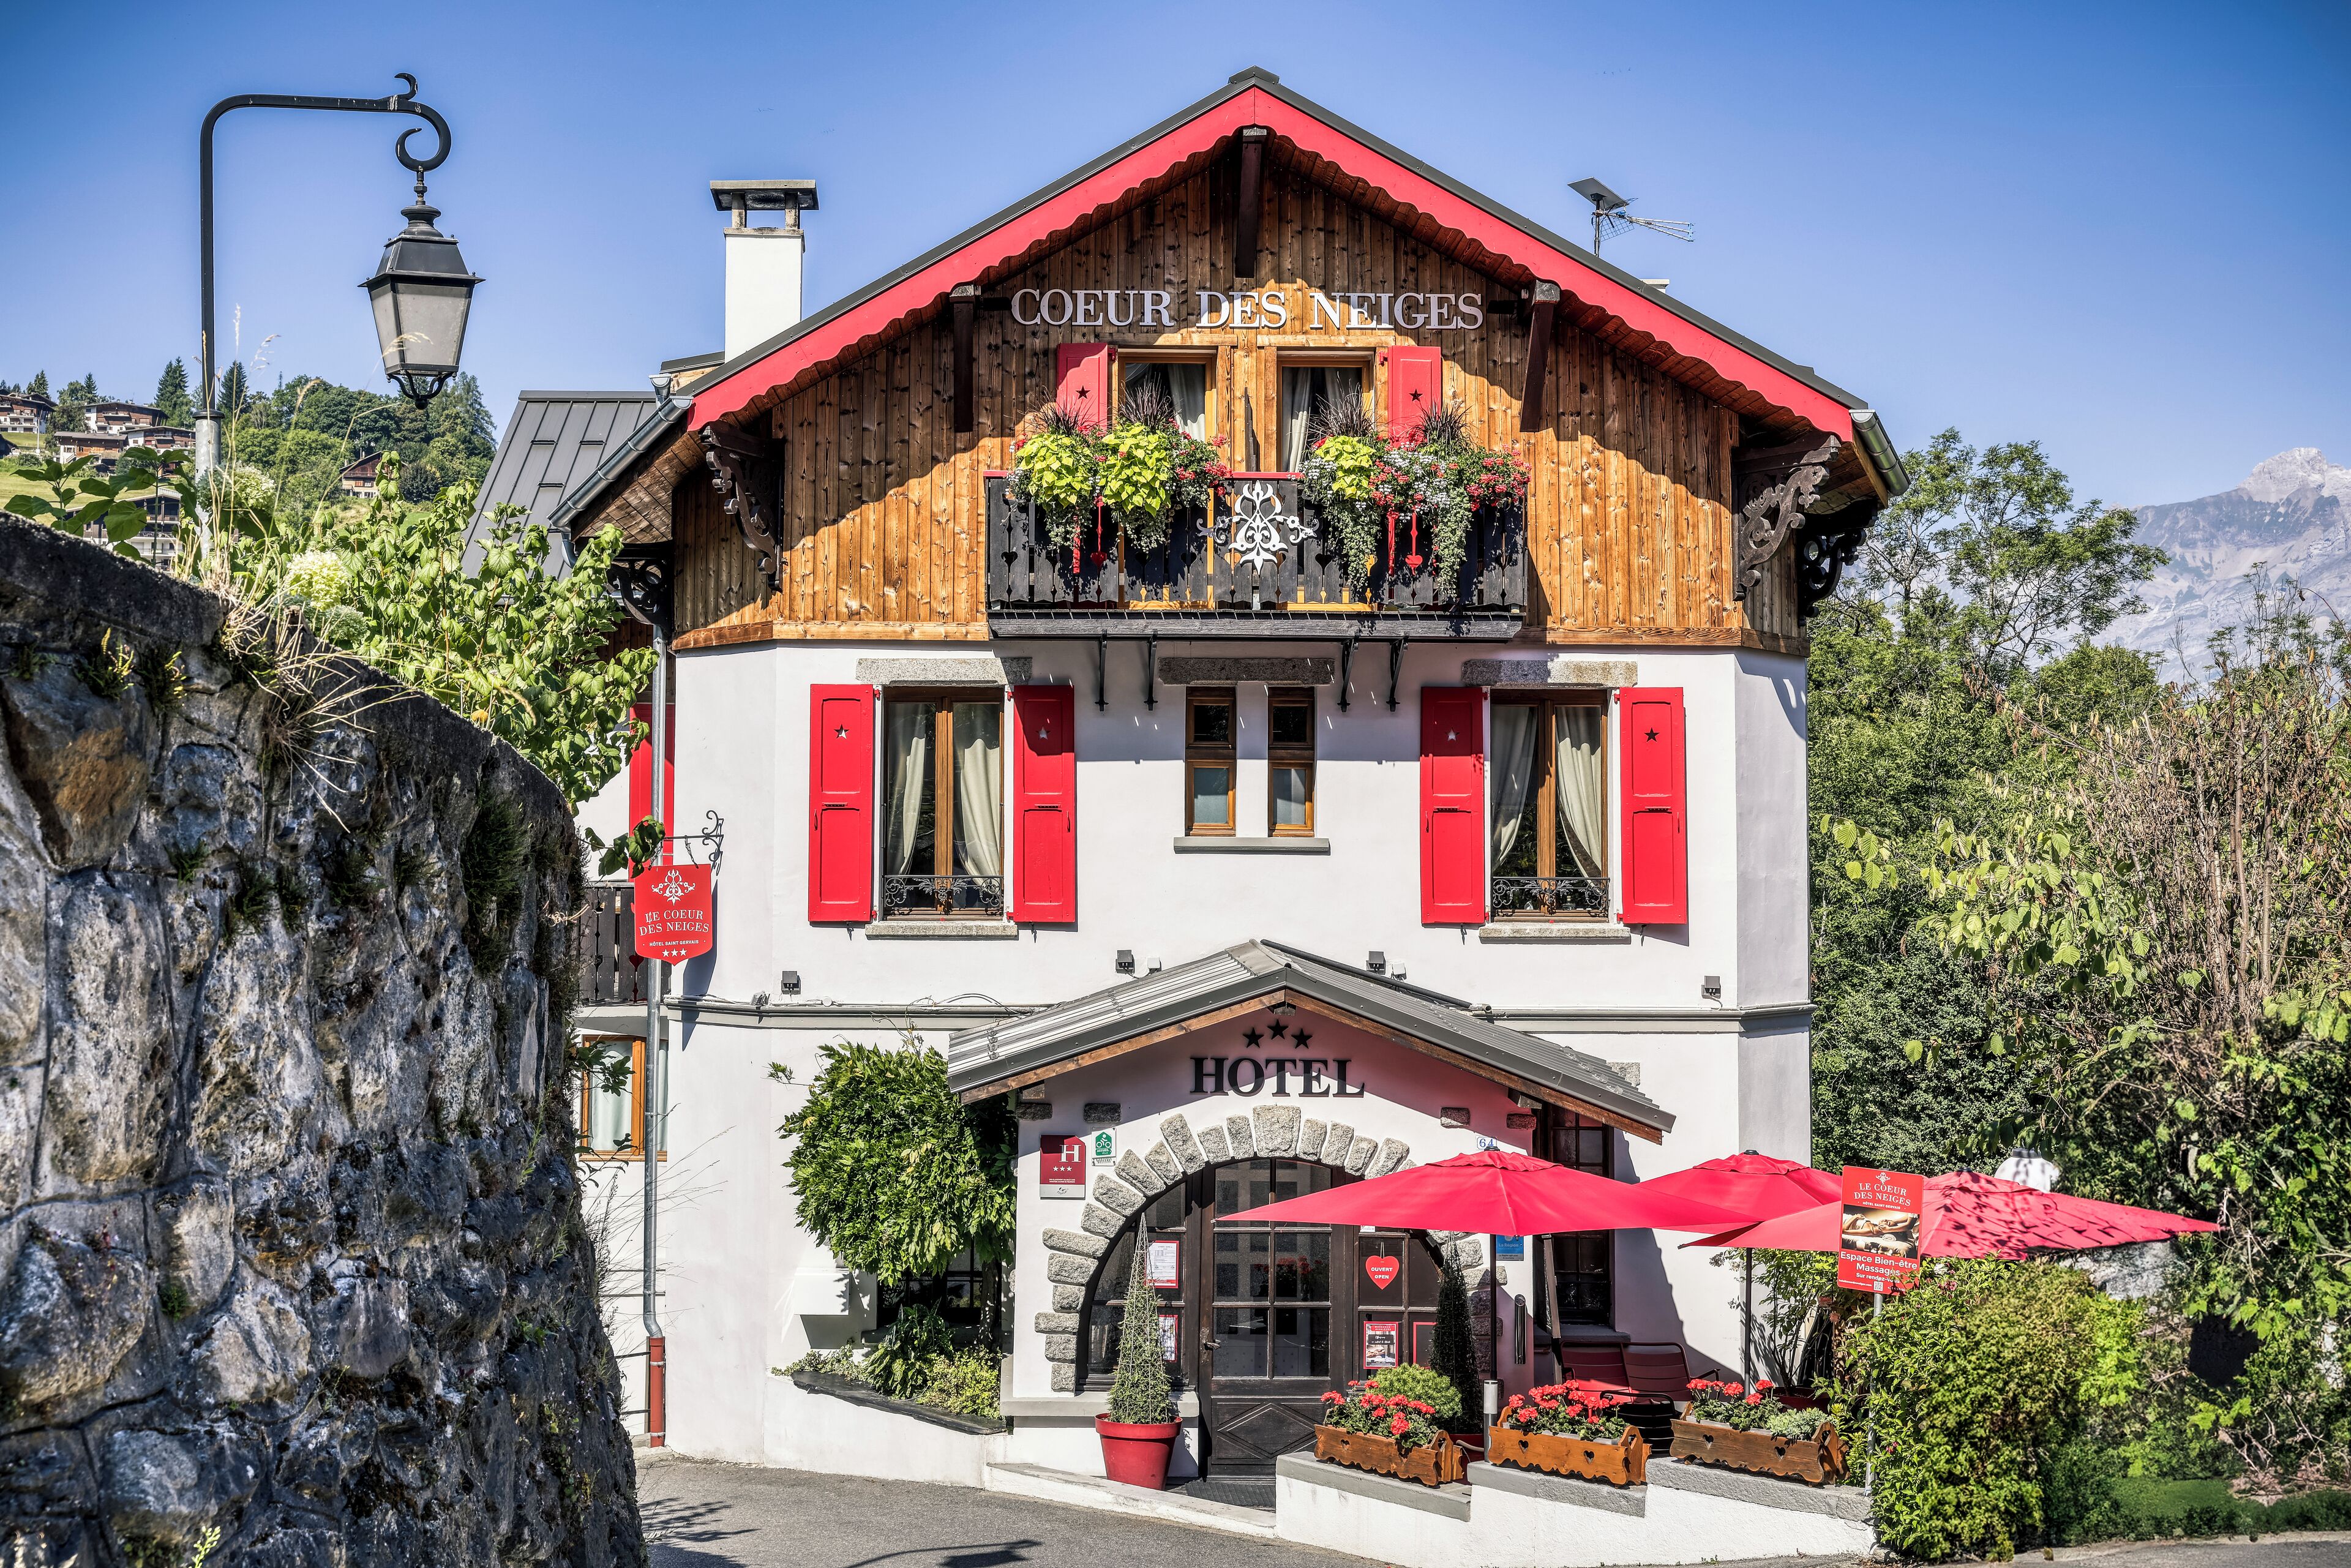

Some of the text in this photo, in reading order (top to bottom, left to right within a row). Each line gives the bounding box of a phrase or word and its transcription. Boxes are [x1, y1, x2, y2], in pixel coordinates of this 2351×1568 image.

[1011, 288, 1483, 330] COEUR DES NEIGES
[645, 909, 703, 923] LE COEUR
[639, 921, 710, 936] DES NEIGES
[1190, 1057, 1365, 1098] HOTEL
[1479, 1138, 1494, 1148] 64
[1059, 1144, 1082, 1163] H
[1873, 1184, 1907, 1196] COEUR
[1854, 1191, 1911, 1207] DES NEIGES
[1840, 1251, 1918, 1270] Espace Bien-être
